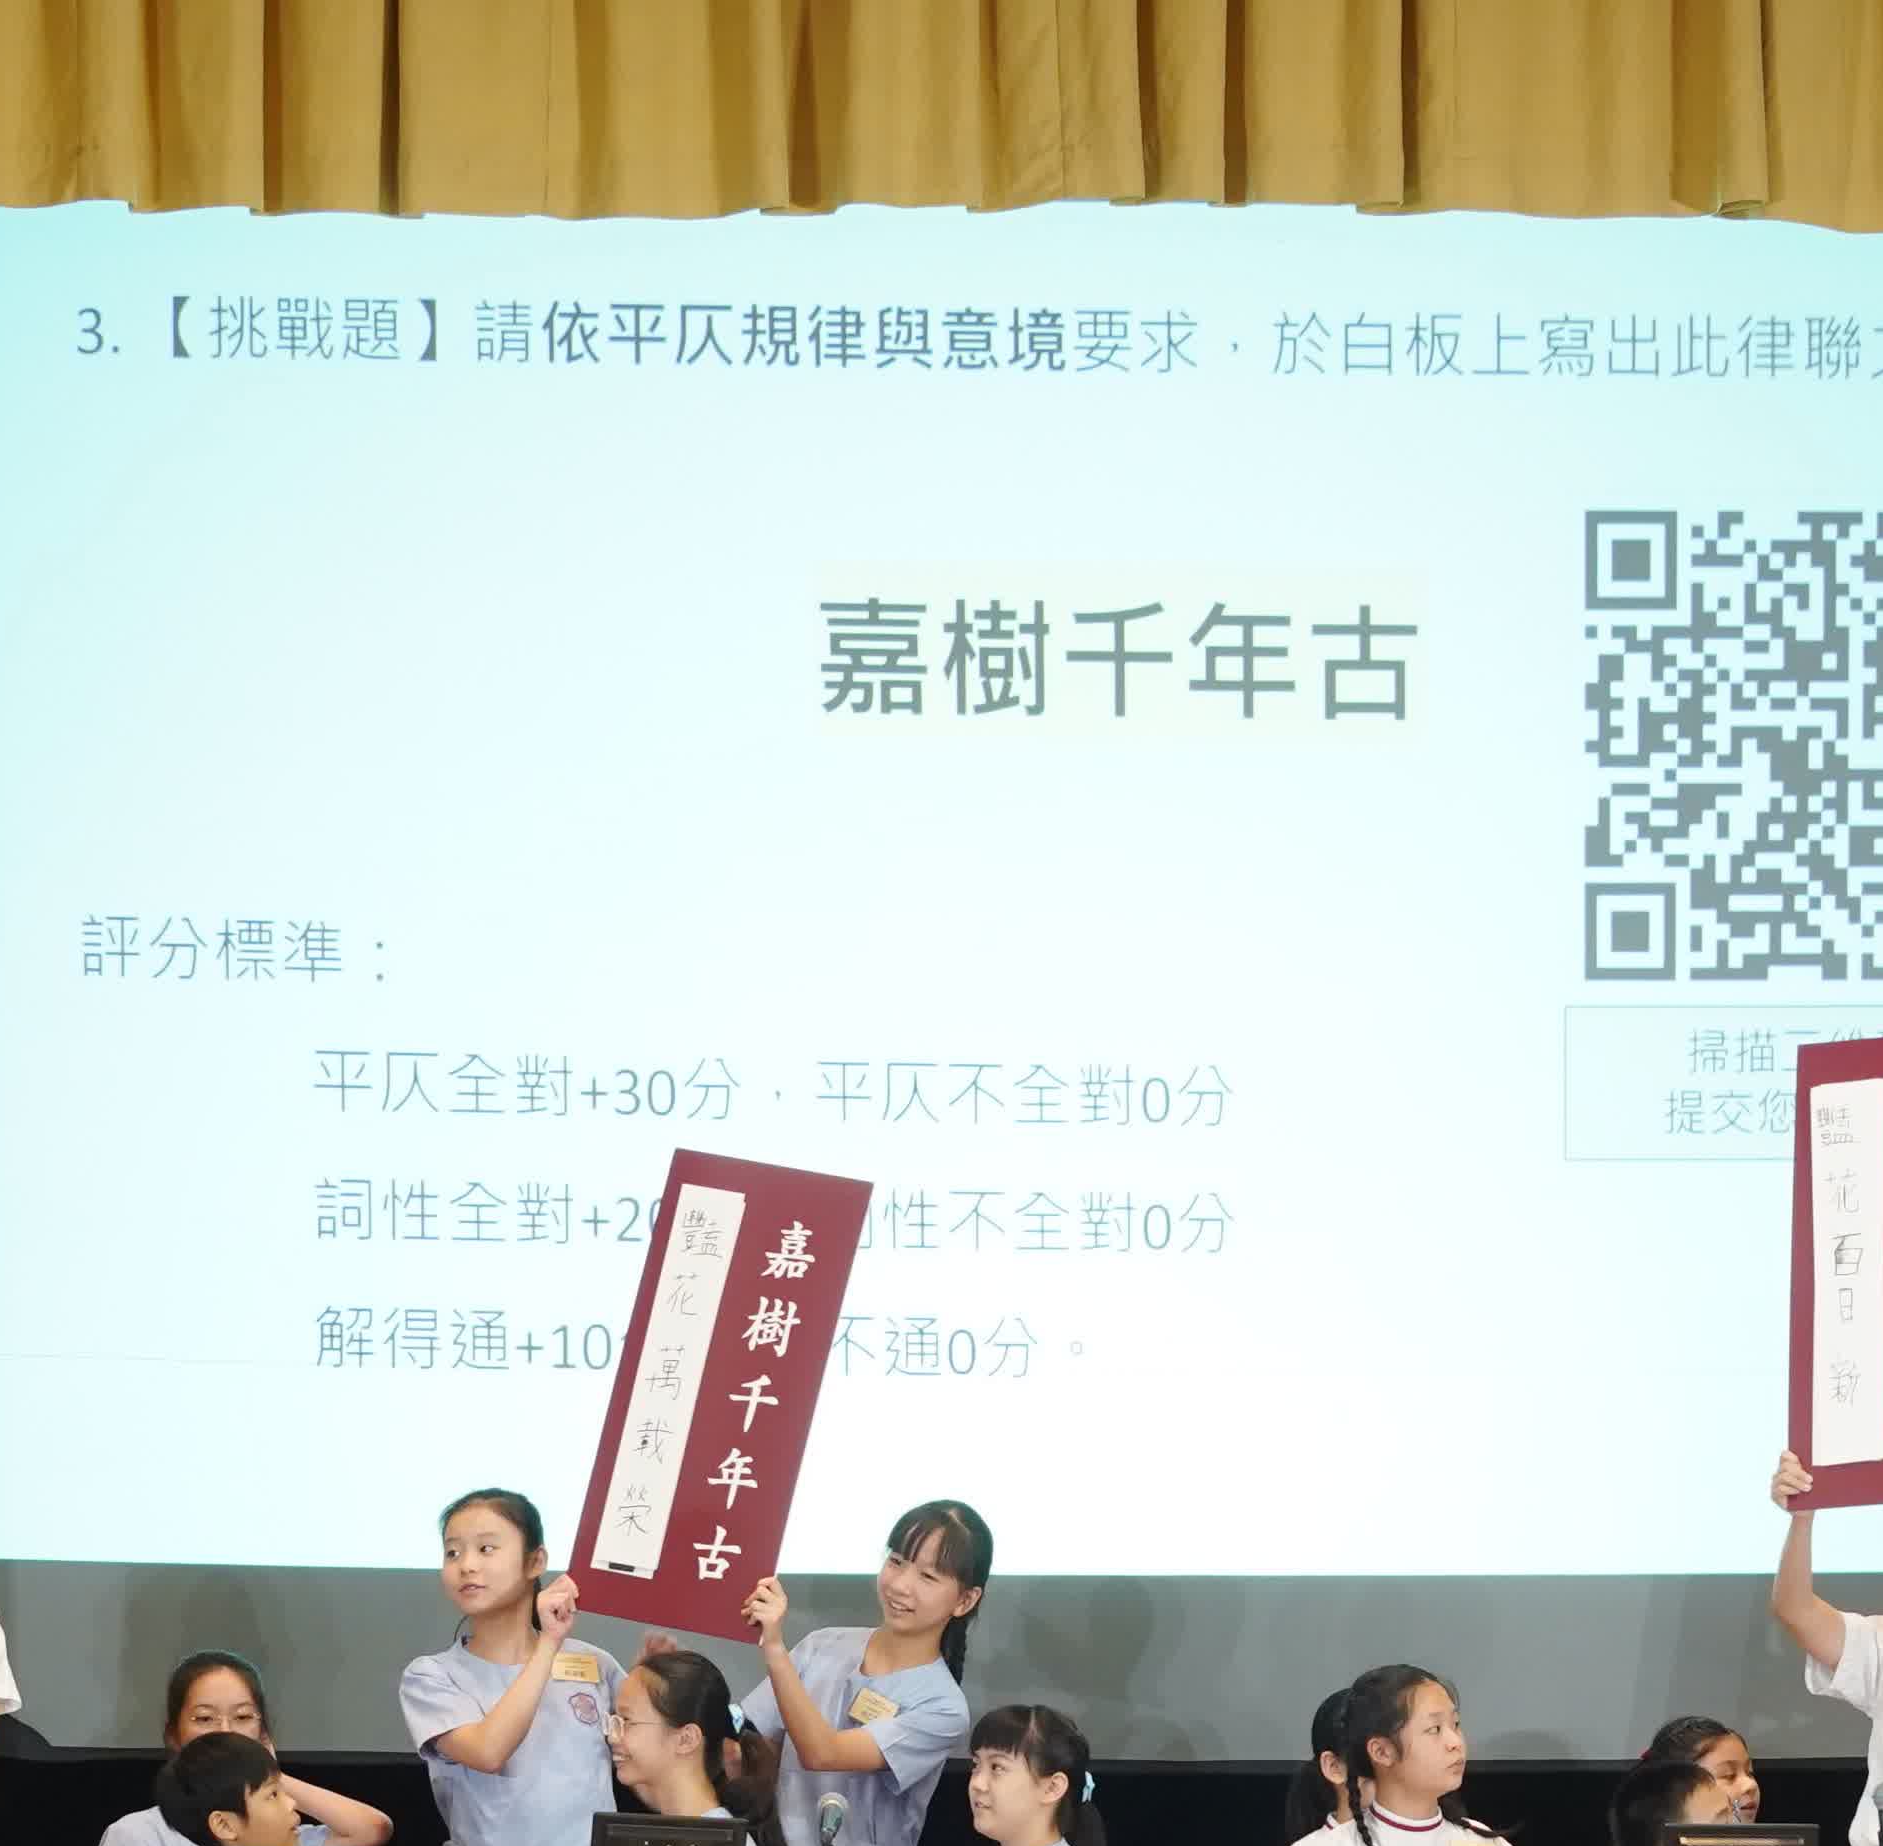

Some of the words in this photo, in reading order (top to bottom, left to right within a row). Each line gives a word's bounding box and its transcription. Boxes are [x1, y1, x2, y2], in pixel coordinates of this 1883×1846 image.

[75, 306, 121, 357] 3.
[817, 597, 1419, 727] 嘉樹千年古
[692, 1220, 817, 1581] 嘉樹千年古
